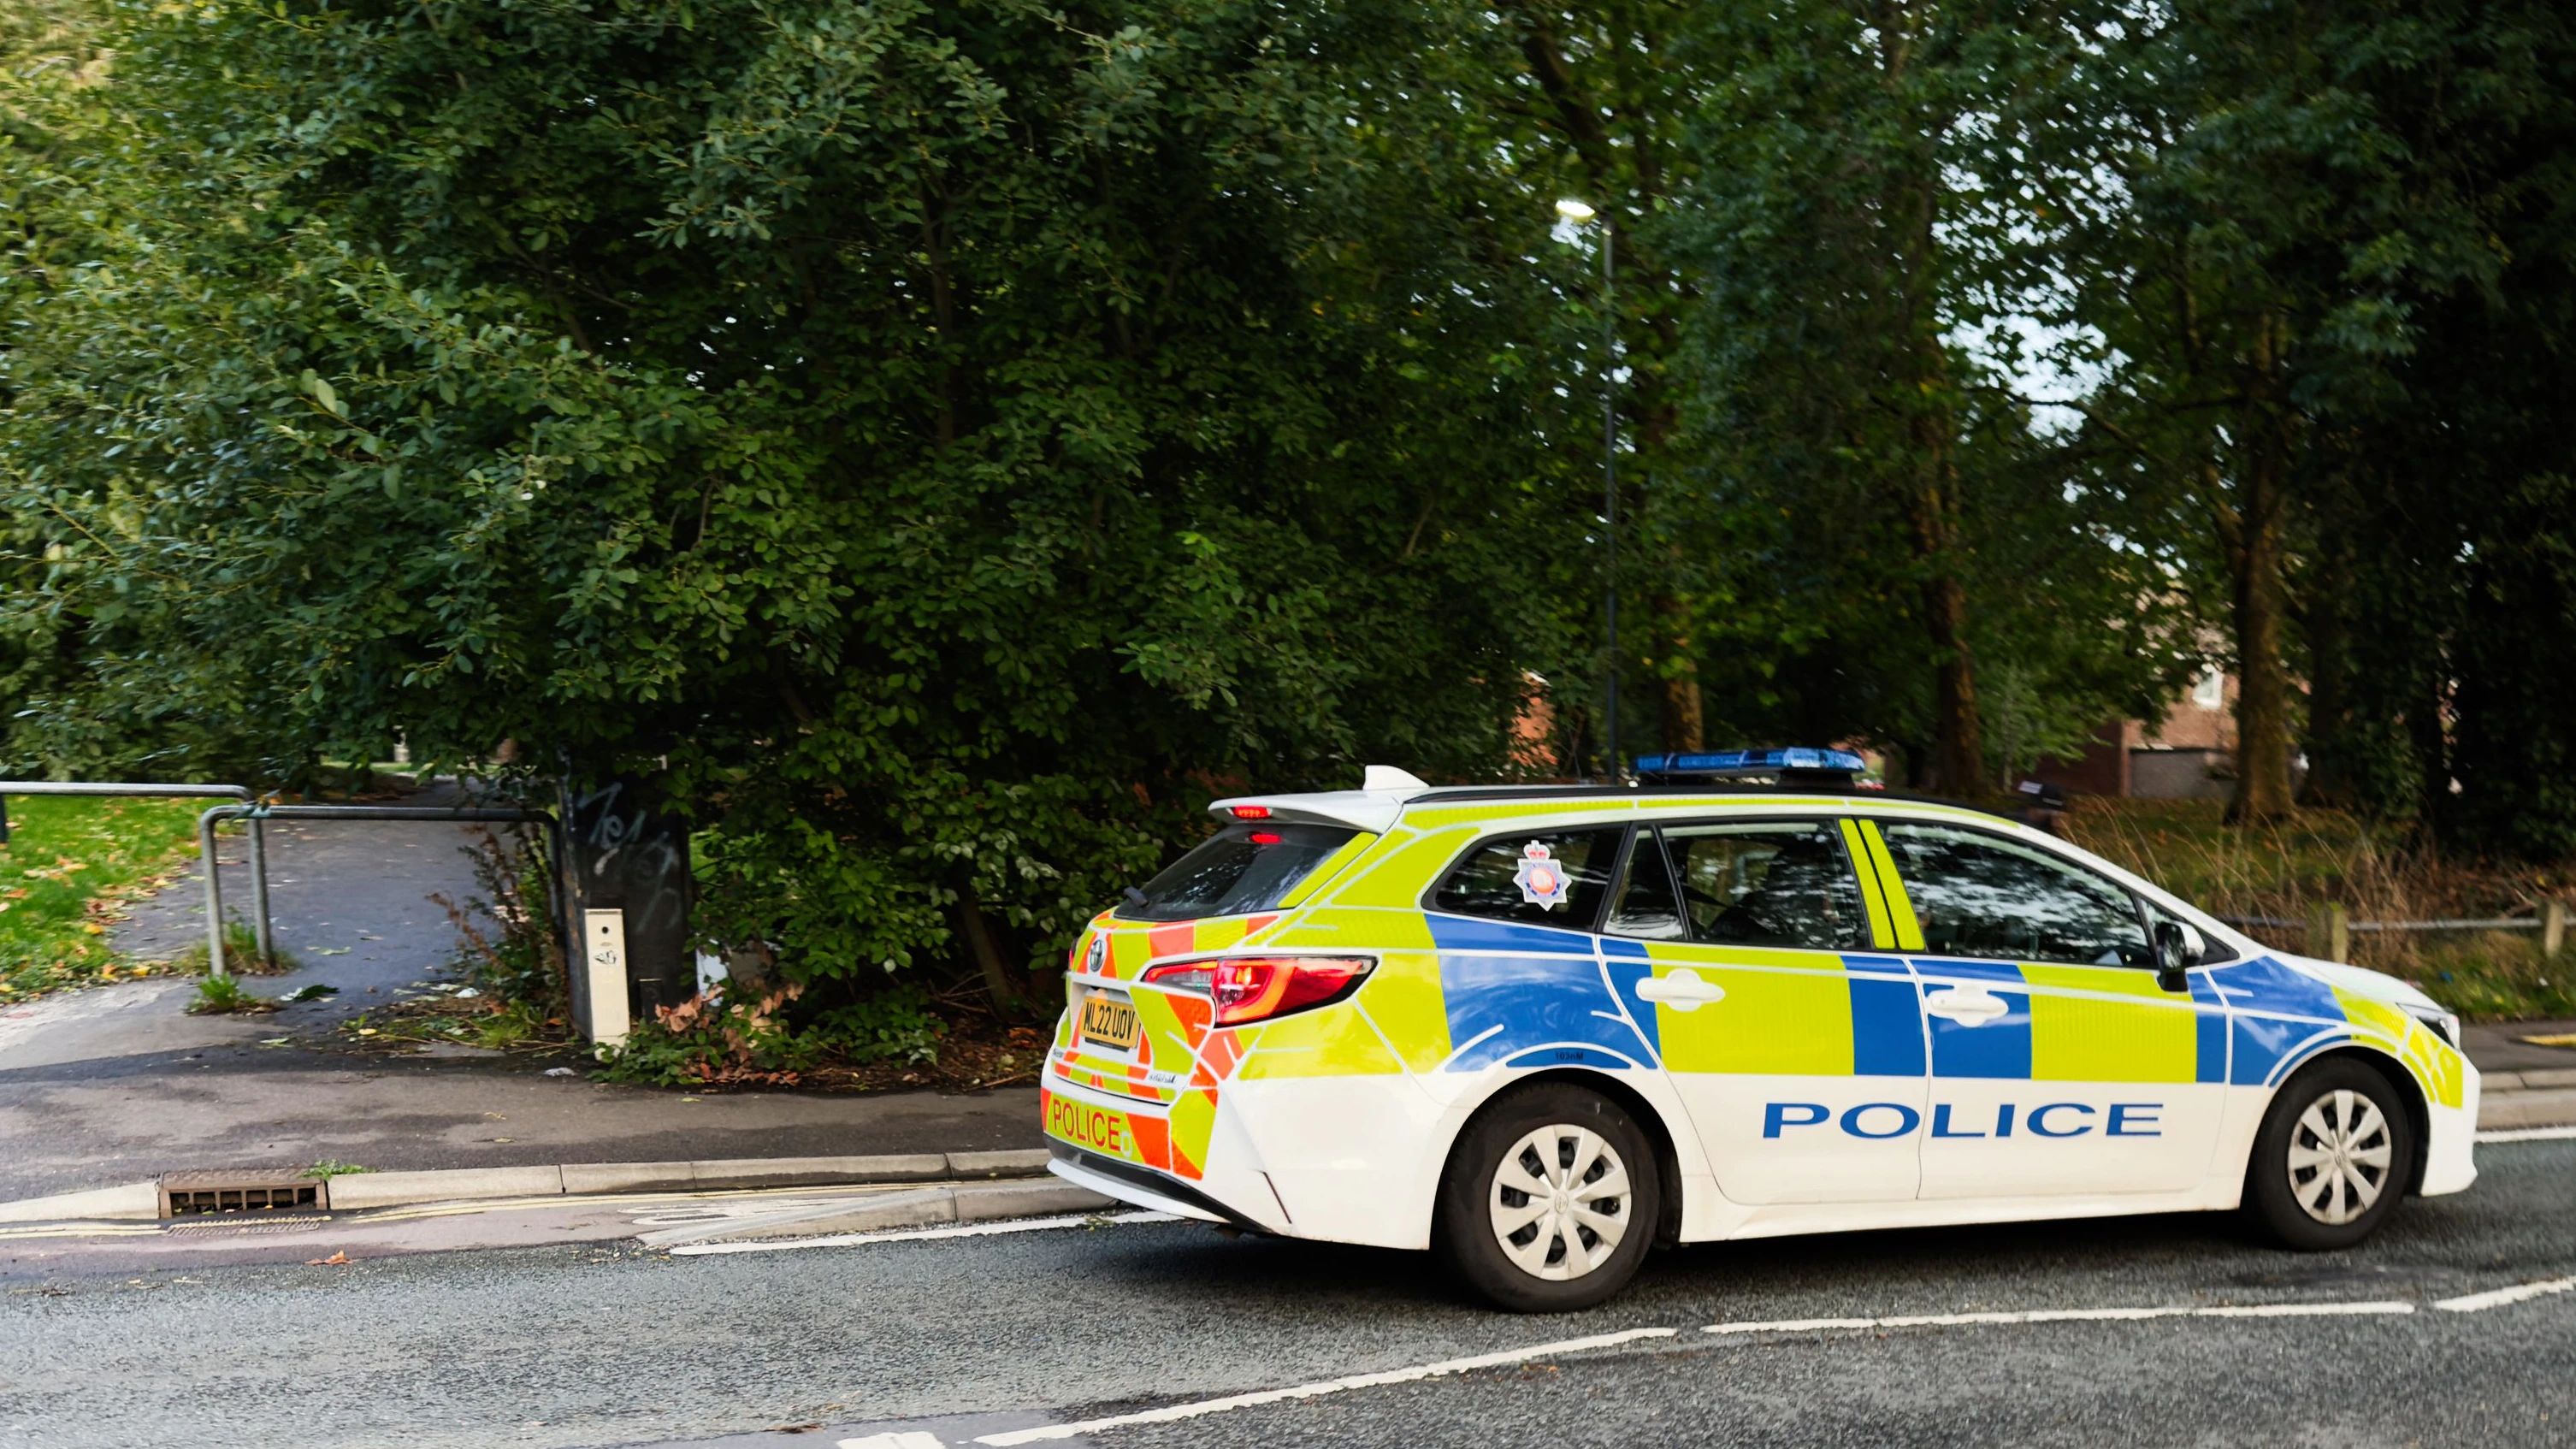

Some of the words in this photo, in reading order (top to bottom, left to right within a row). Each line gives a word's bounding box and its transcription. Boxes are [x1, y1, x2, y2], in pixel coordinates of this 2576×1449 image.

[1084, 1002, 1111, 1035] ML22
[1112, 1008, 1135, 1040] UOV
[1054, 1099, 1120, 1151] POLICE
[1763, 1103, 2163, 1138] POLICE
